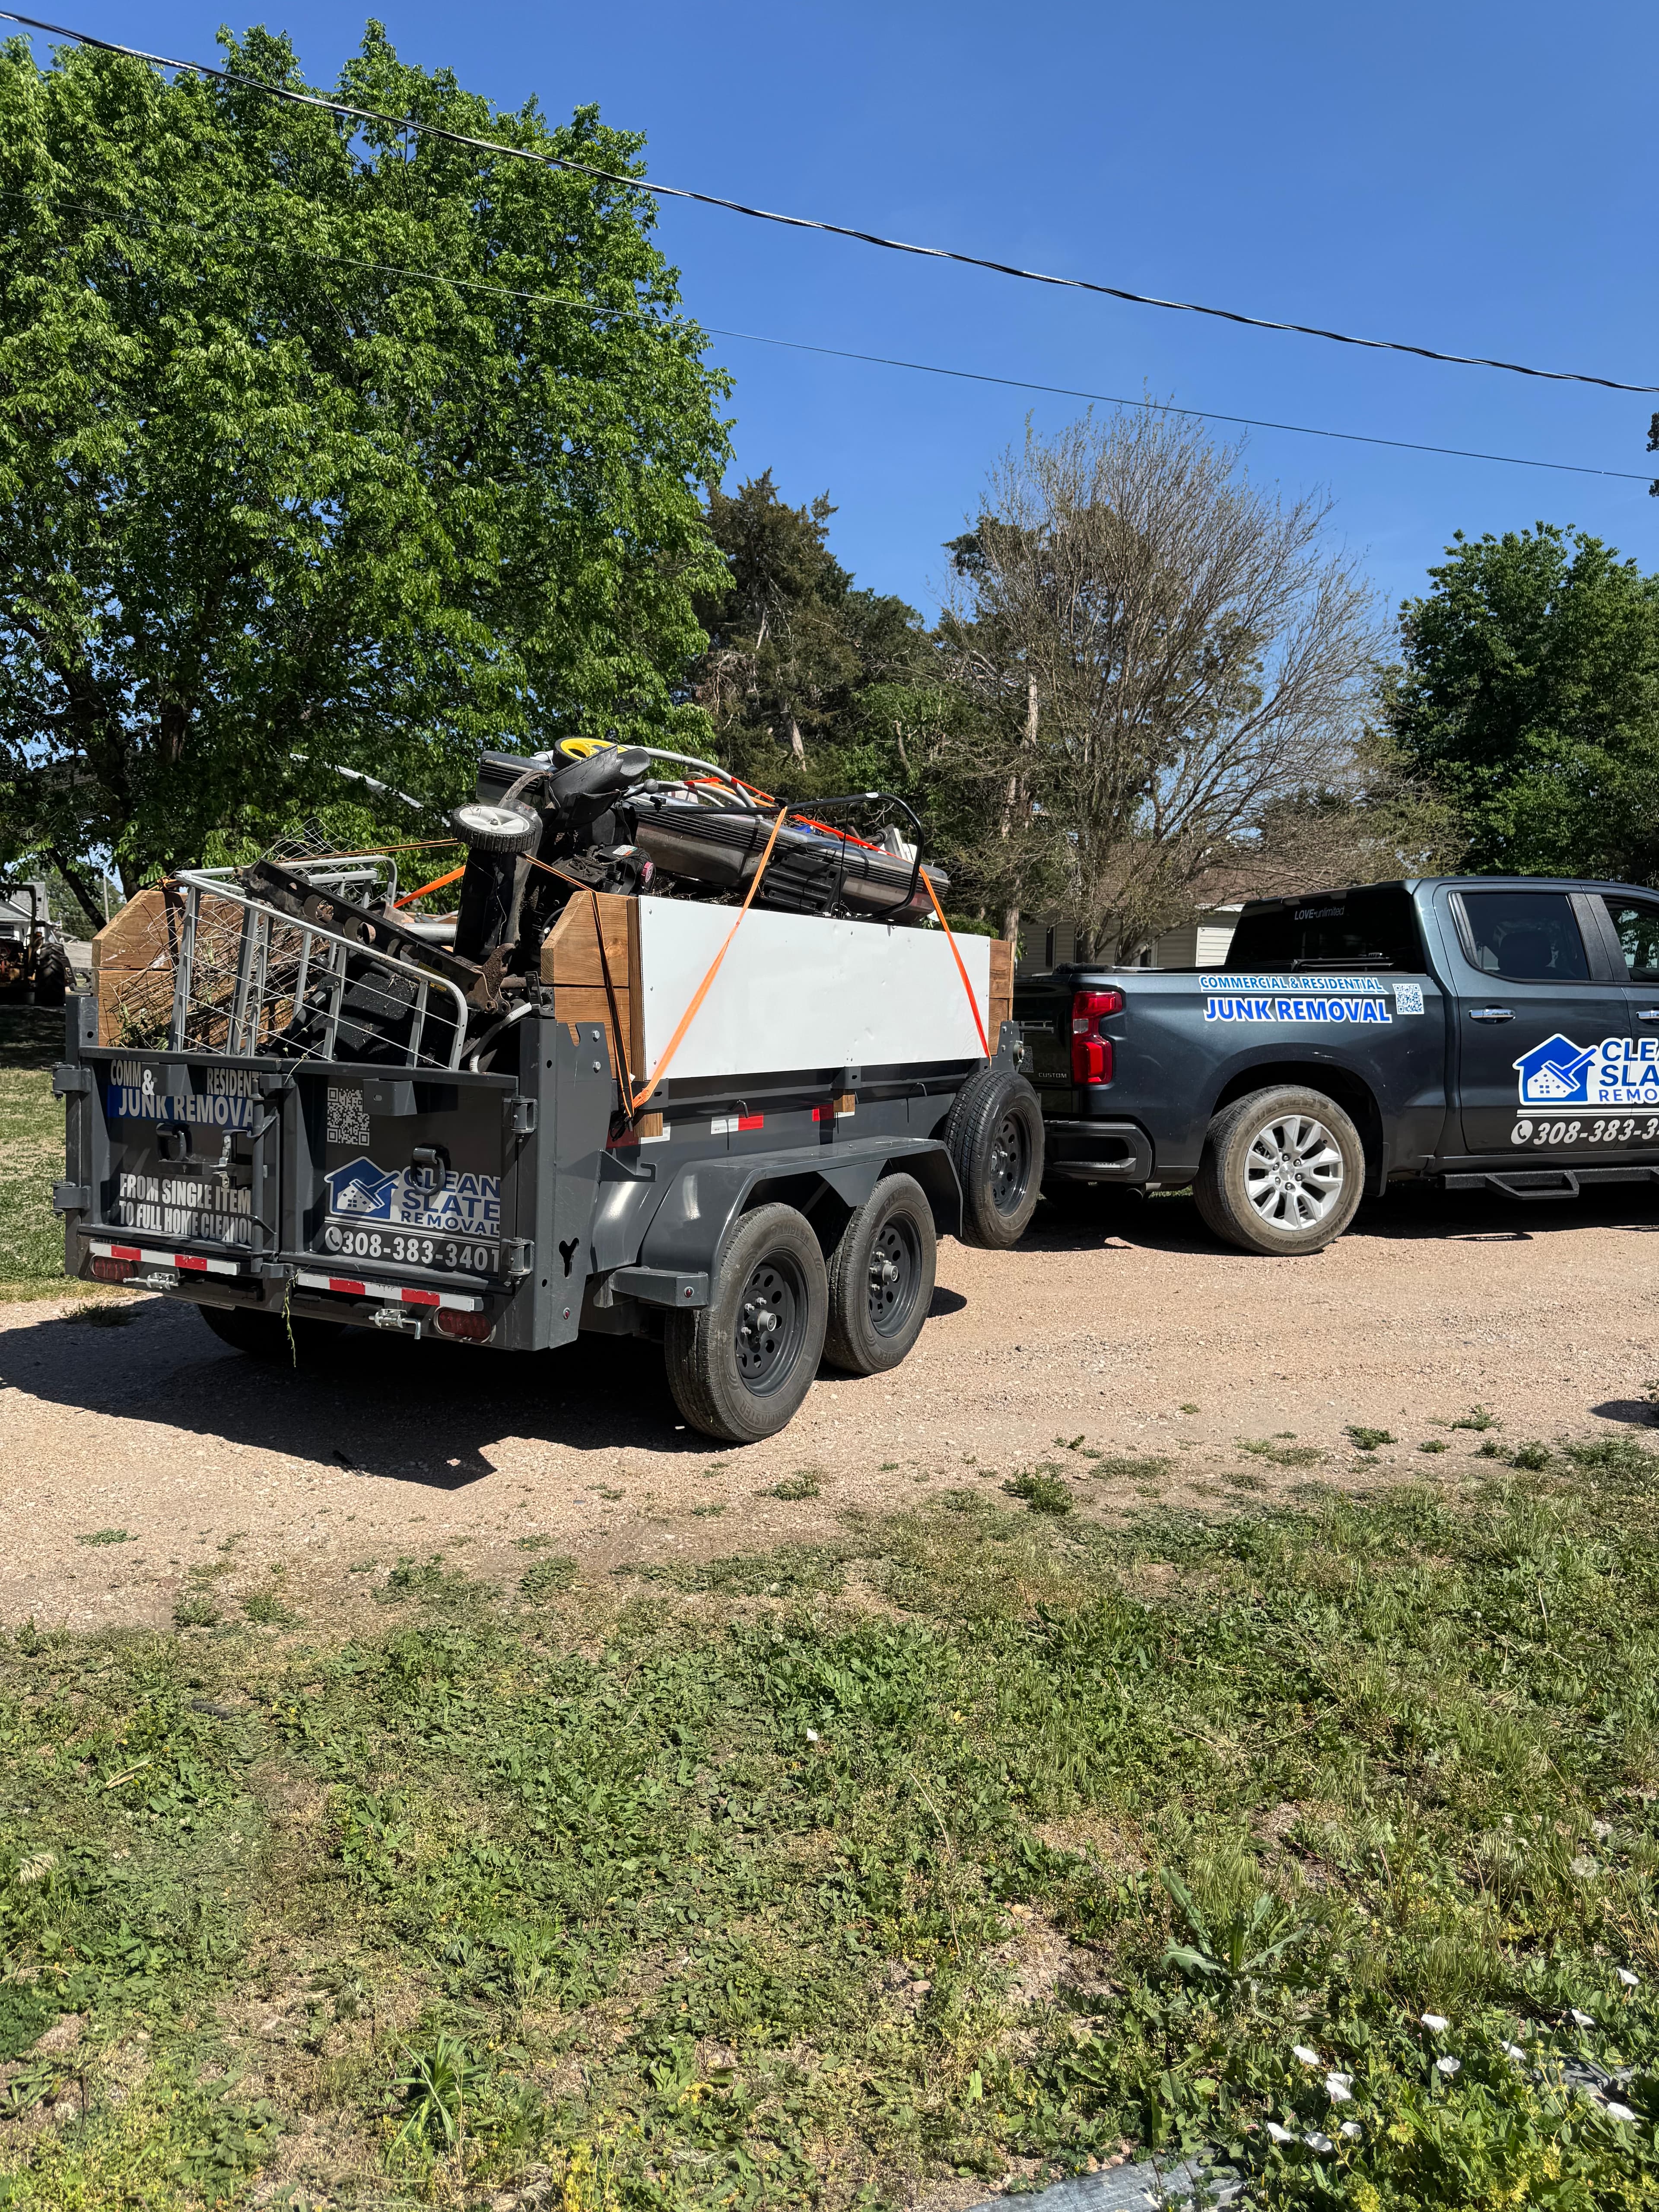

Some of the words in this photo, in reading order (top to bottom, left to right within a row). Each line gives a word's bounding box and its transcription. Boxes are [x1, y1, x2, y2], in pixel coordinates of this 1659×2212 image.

[1201, 977, 1287, 988] COMMERCIAL
[1290, 978, 1299, 988] &
[1302, 978, 1382, 990] RESIDENTIAL
[1206, 999, 1272, 1020] JUNK
[1278, 1001, 1391, 1021] REMOVAL
[1602, 1041, 1659, 1062] CLE
[141, 1069, 155, 1096] &
[1599, 1064, 1659, 1087] SLA
[118, 1088, 169, 1119] JUNK
[1599, 1088, 1658, 1102] REMO
[1533, 1118, 1659, 1145] 308-383-3
[119, 1173, 159, 1202] FROM
[162, 1179, 212, 1210] SINGLE
[216, 1186, 251, 1214] ITEM
[403, 1169, 501, 1198] CLEAN
[119, 1200, 134, 1226] TO
[136, 1203, 162, 1231] FULL
[164, 1207, 199, 1236] HOME
[402, 1189, 500, 1222] SLATE
[400, 1211, 499, 1236] REMOVAL
[341, 1230, 500, 1273] 308-383-3401
